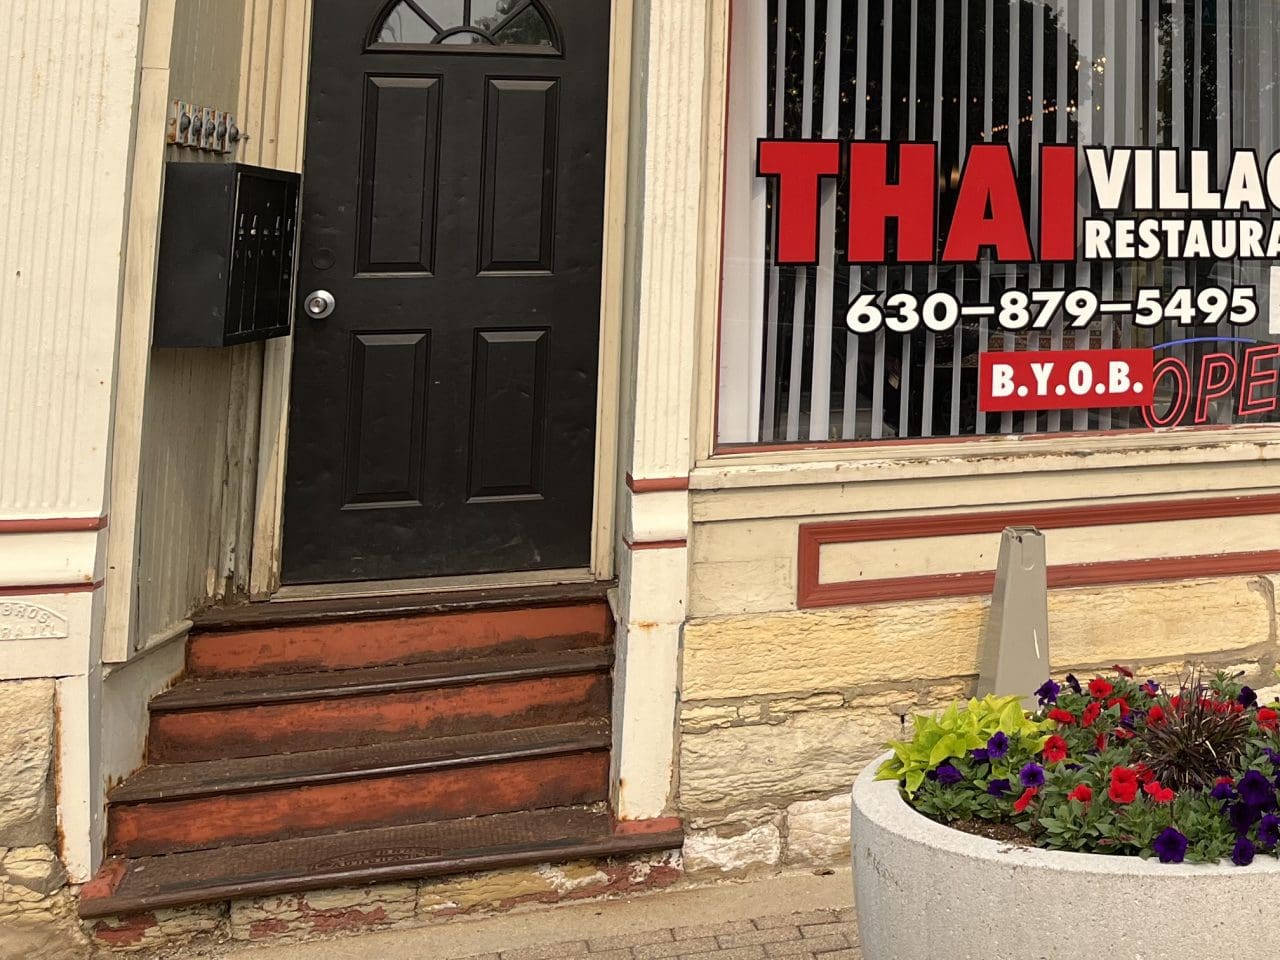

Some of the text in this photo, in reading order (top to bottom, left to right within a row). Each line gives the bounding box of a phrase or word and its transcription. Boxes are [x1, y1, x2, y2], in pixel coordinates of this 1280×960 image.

[757, 139, 1076, 265] THAI
[845, 285, 1258, 334] 630-879-5495
[991, 359, 1144, 397] B.Y.O.B.
